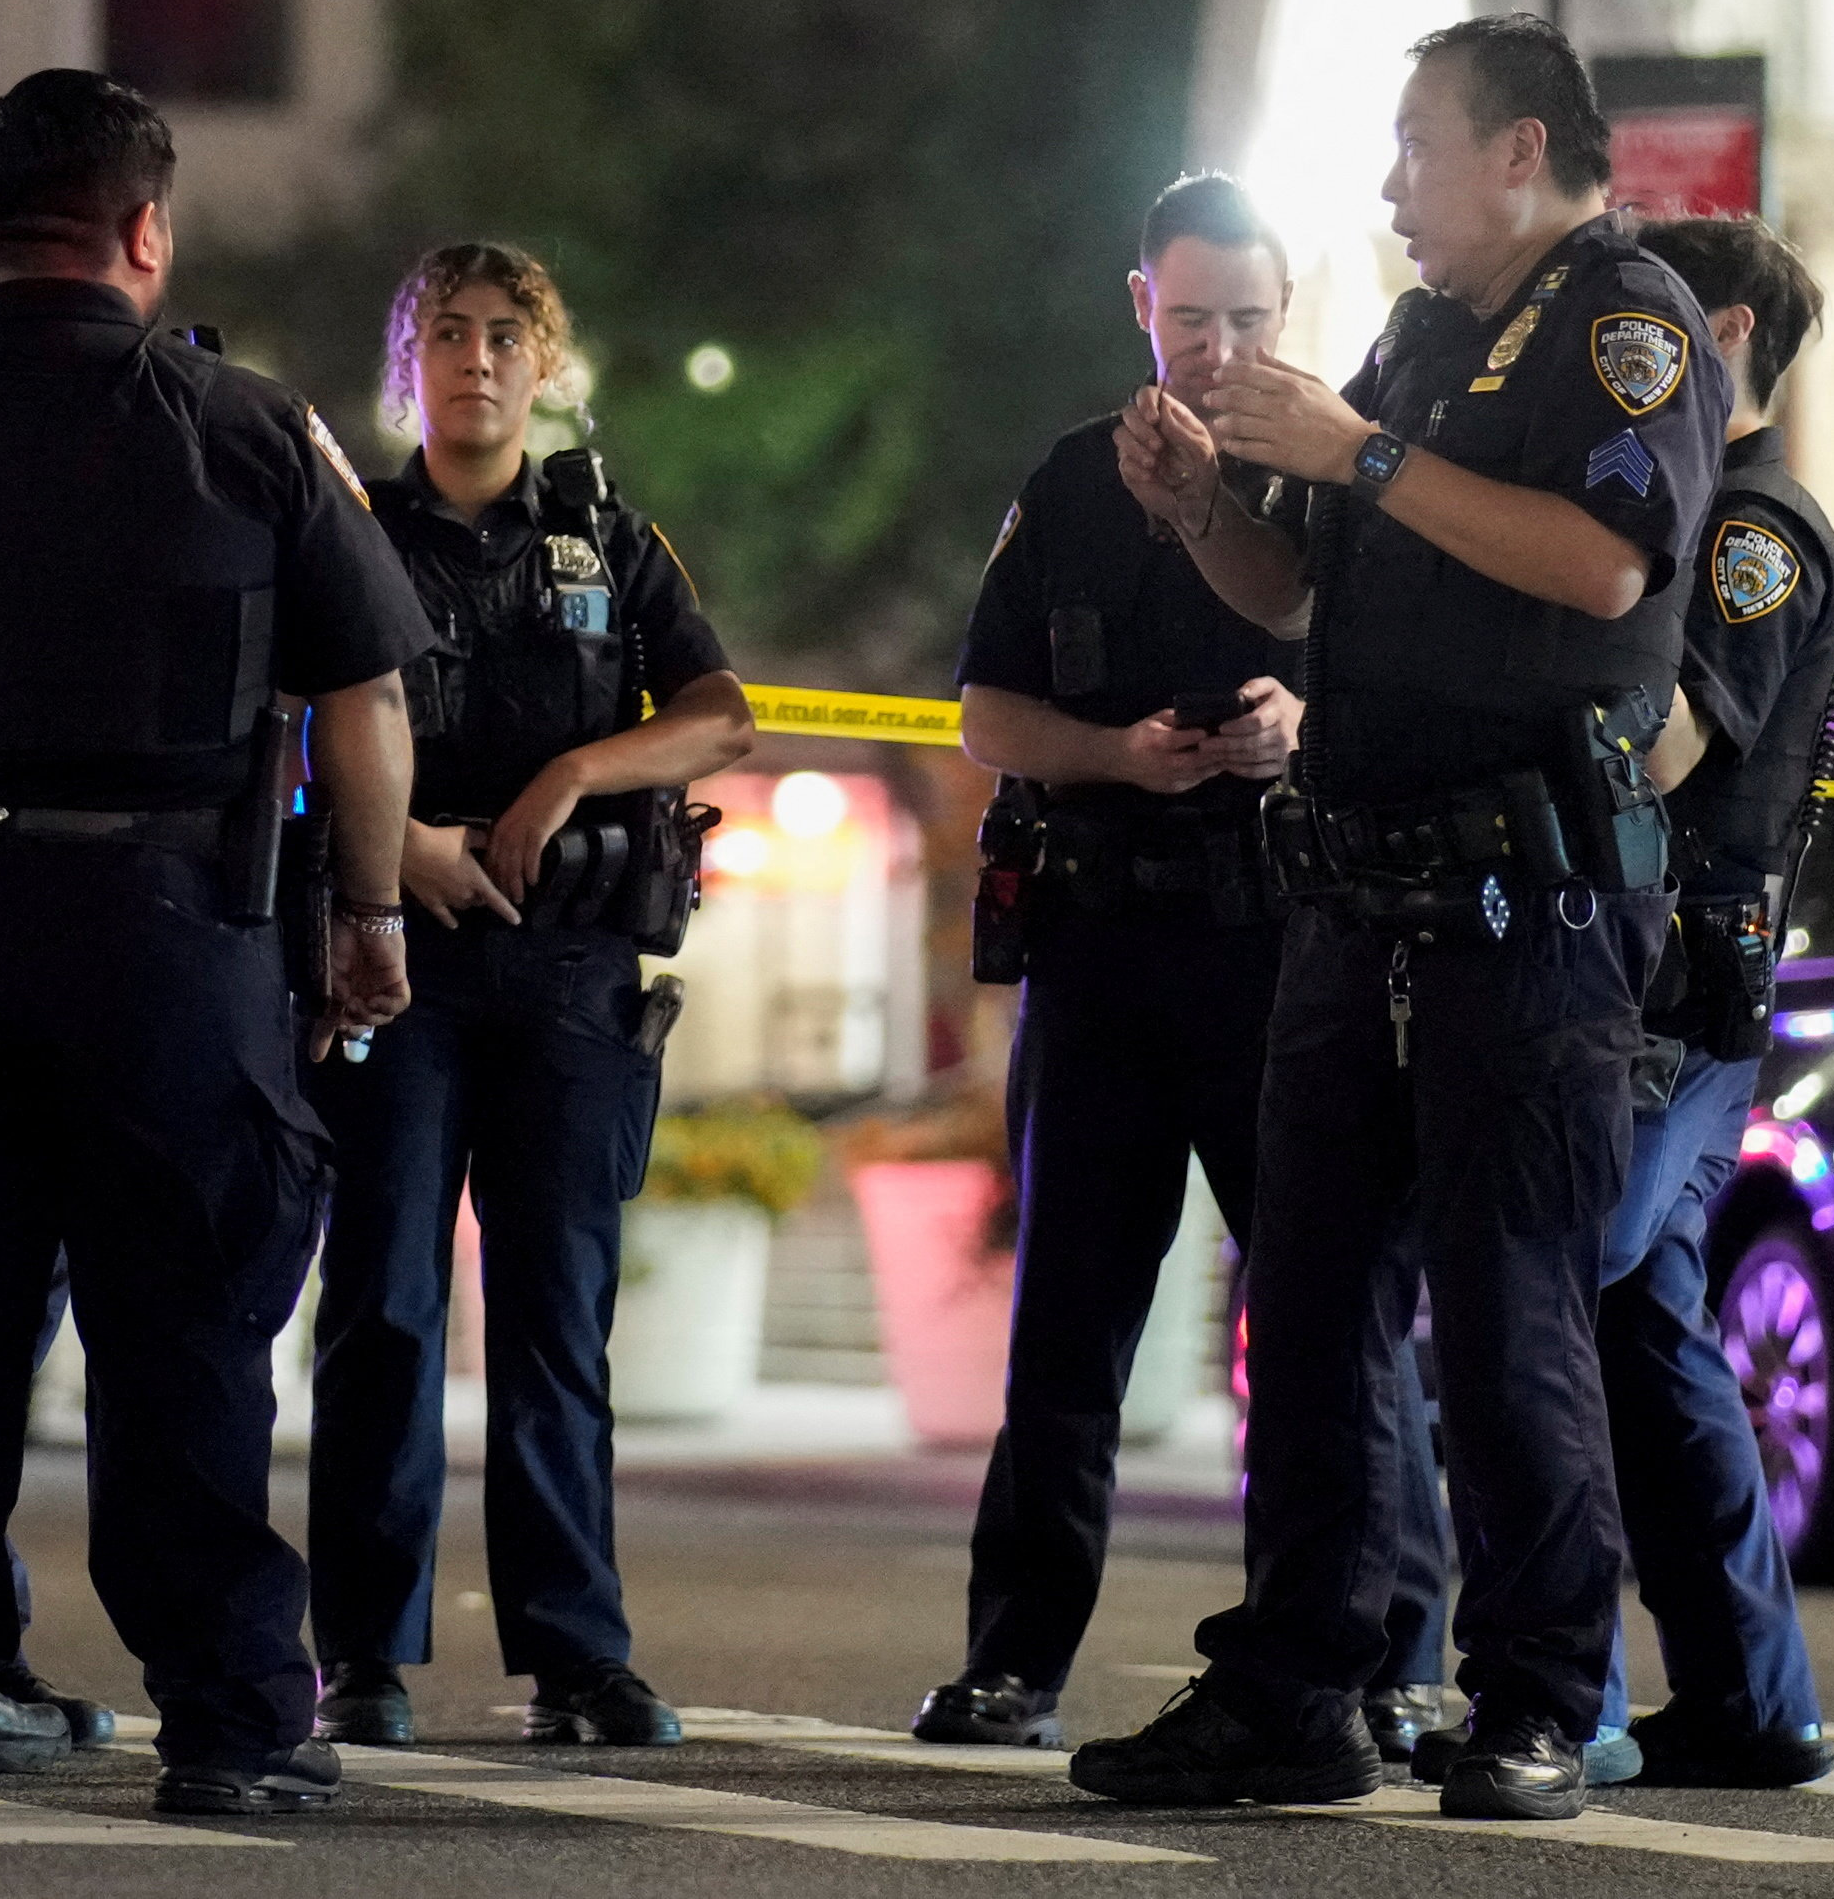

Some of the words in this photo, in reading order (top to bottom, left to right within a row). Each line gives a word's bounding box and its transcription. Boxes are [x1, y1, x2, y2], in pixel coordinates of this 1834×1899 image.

[1601, 331, 1678, 357] DEPARTMENT
[1619, 321, 1664, 338] POLICE
[1599, 355, 1615, 379] CITY
[1611, 380, 1627, 395] OF
[1641, 387, 1663, 405] NEW
[1660, 362, 1678, 389] YORK
[1725, 536, 1792, 579] DEPARTMENT
[1745, 530, 1784, 559] POLICE
[1717, 557, 1727, 582] CITY
